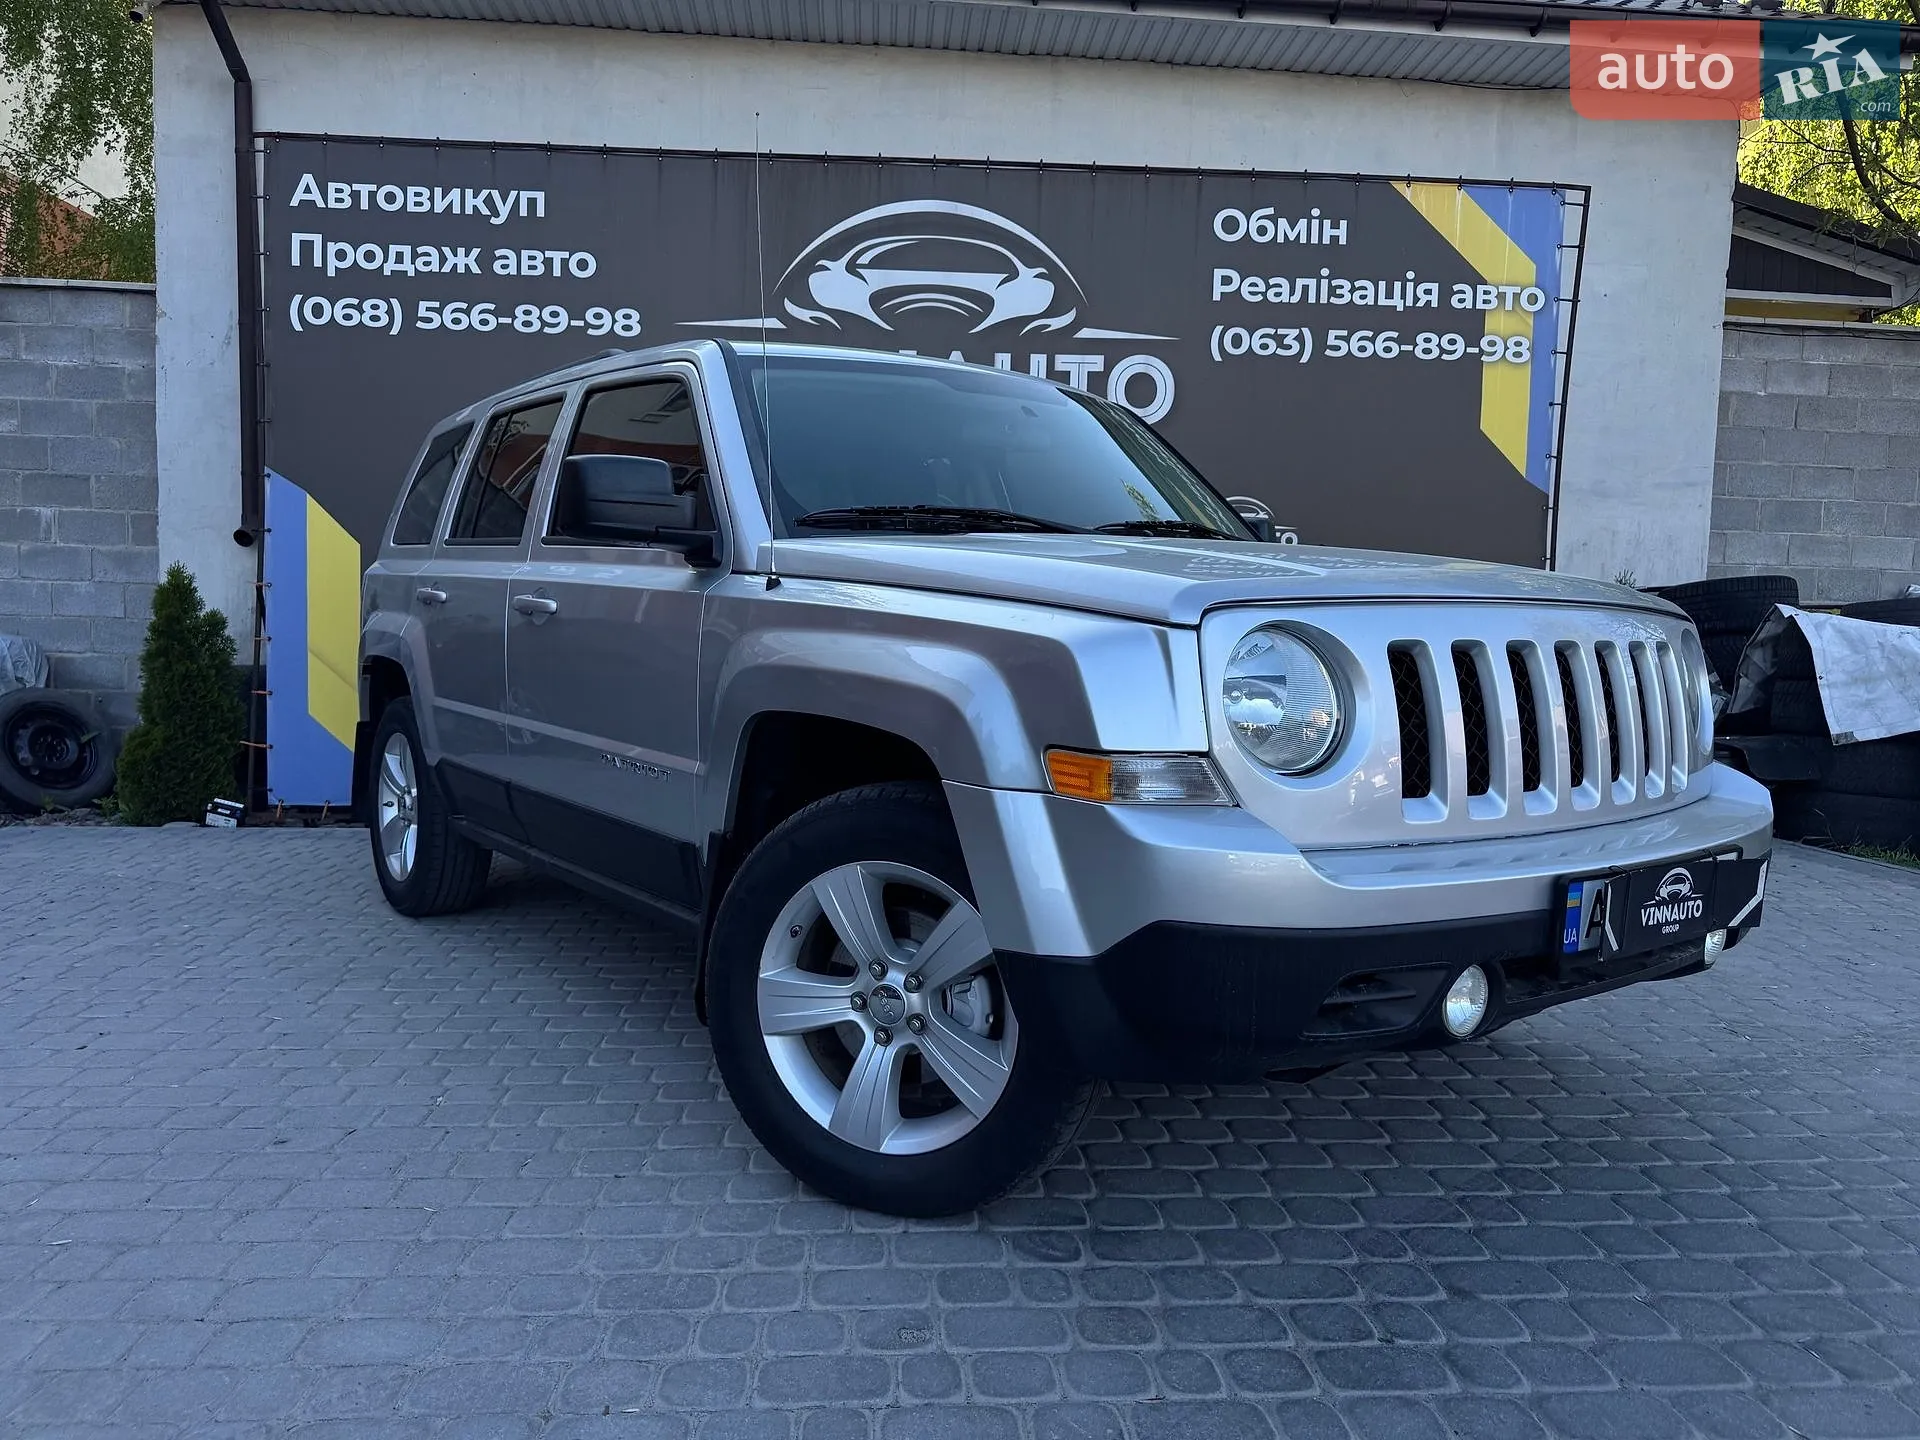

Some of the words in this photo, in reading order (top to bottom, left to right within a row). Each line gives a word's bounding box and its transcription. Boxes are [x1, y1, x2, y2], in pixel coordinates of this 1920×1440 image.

[289, 173, 545, 225] Автовикуп
[1213, 207, 1348, 245] Обмін
[290, 232, 482, 277] Продаж
[492, 247, 598, 279] авто
[1212, 267, 1440, 311] Реалізація
[1450, 284, 1546, 313] авто
[289, 294, 403, 335] (068)
[415, 300, 642, 338] 566-89-98
[1210, 325, 1313, 364] (063)
[1324, 329, 1532, 364] 566-89-98
[600, 753, 671, 781] PATRIOT
[1641, 899, 1703, 927] VINNAUTO
[1661, 923, 1680, 934] GROUP
[1563, 928, 1577, 944] UA
